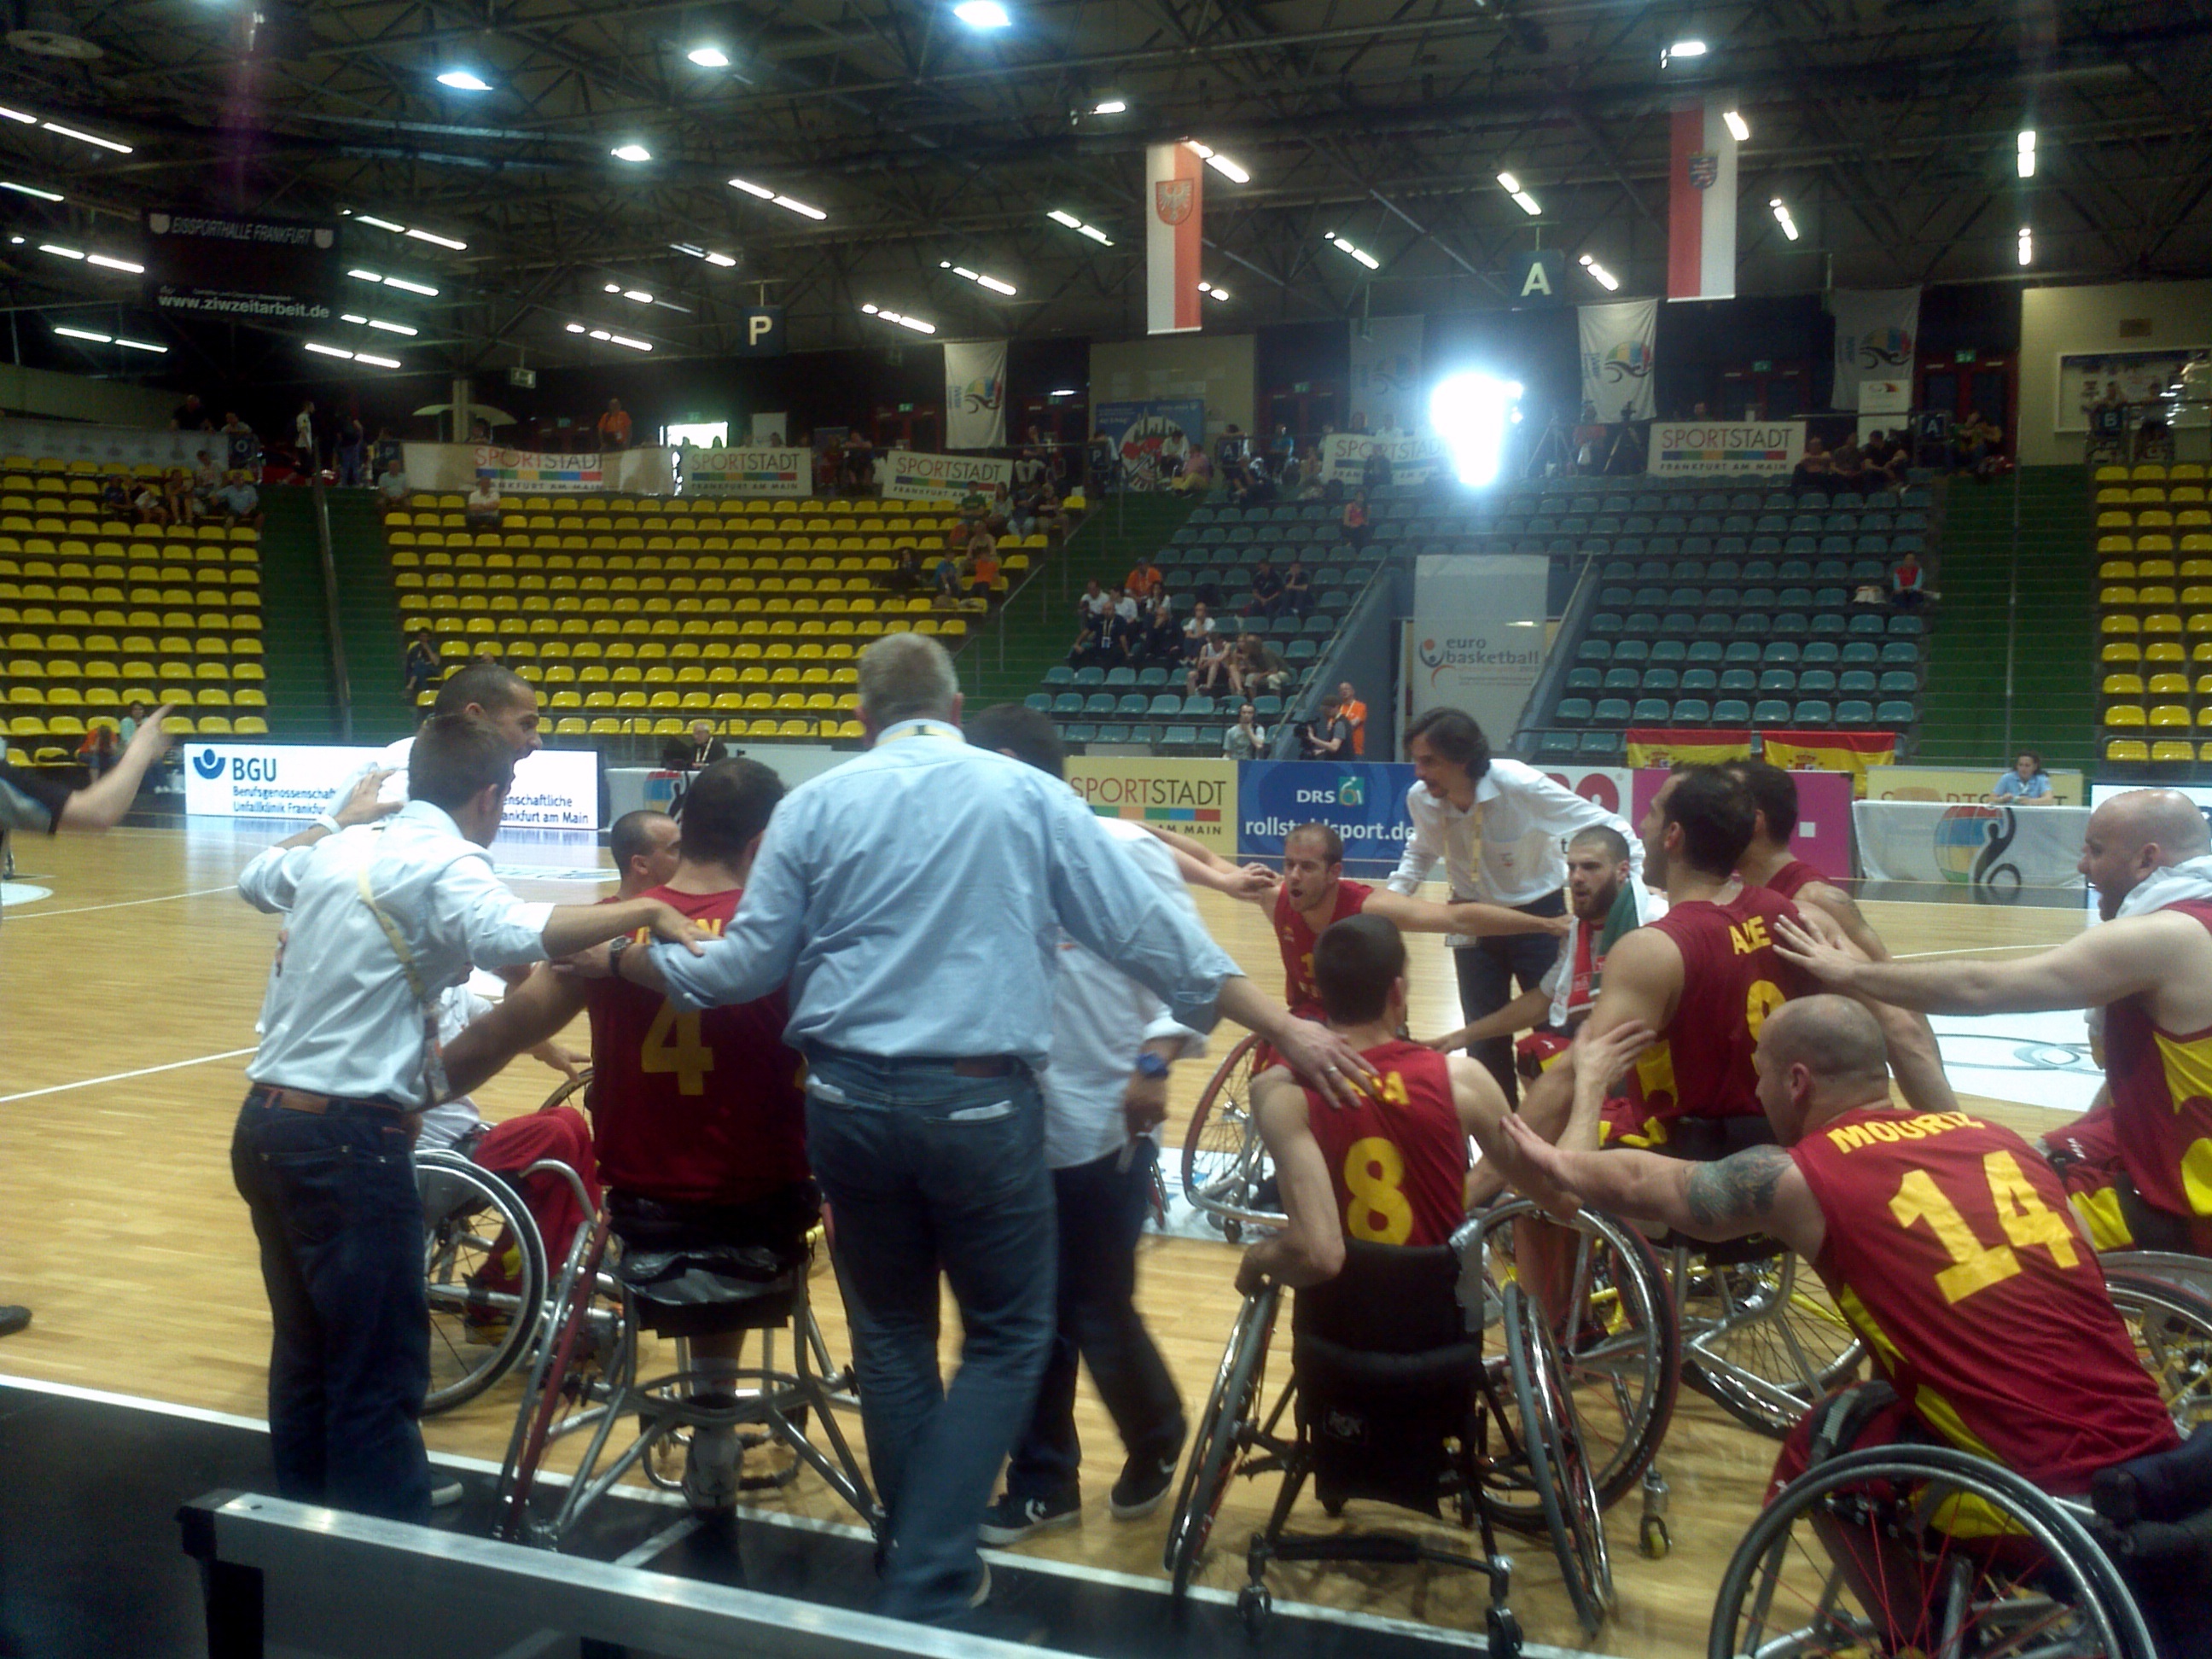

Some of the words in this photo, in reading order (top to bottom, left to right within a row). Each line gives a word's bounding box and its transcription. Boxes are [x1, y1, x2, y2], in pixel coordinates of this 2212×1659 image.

[172, 217, 253, 240] EISSPORTHALLE
[254, 224, 311, 245] FRANKFURT
[1520, 261, 1552, 297] A
[158, 294, 330, 319] www.ziwzeitarbeit.de
[748, 315, 773, 346] P
[1926, 418, 1940, 434] A
[1662, 428, 1792, 449] SPORTSTADT
[691, 452, 800, 471] SPORTSTADT
[896, 457, 1002, 481] SPORTSTADT
[1447, 638, 1487, 649] euro
[1447, 650, 1540, 665] basketball
[232, 757, 277, 783] BGU
[504, 794, 573, 807] enschaftliche
[1070, 777, 1227, 806] SPORTSTADT
[1295, 789, 1336, 804] DRS
[288, 803, 326, 815] Frankfur
[503, 810, 540, 823] ankfurt
[543, 813, 559, 823] am
[562, 812, 589, 824] Main
[1184, 824, 1222, 835] MAIN
[641, 995, 715, 1096] 4
[1344, 1136, 1413, 1247] 8
[1888, 1150, 2081, 1305] 14
